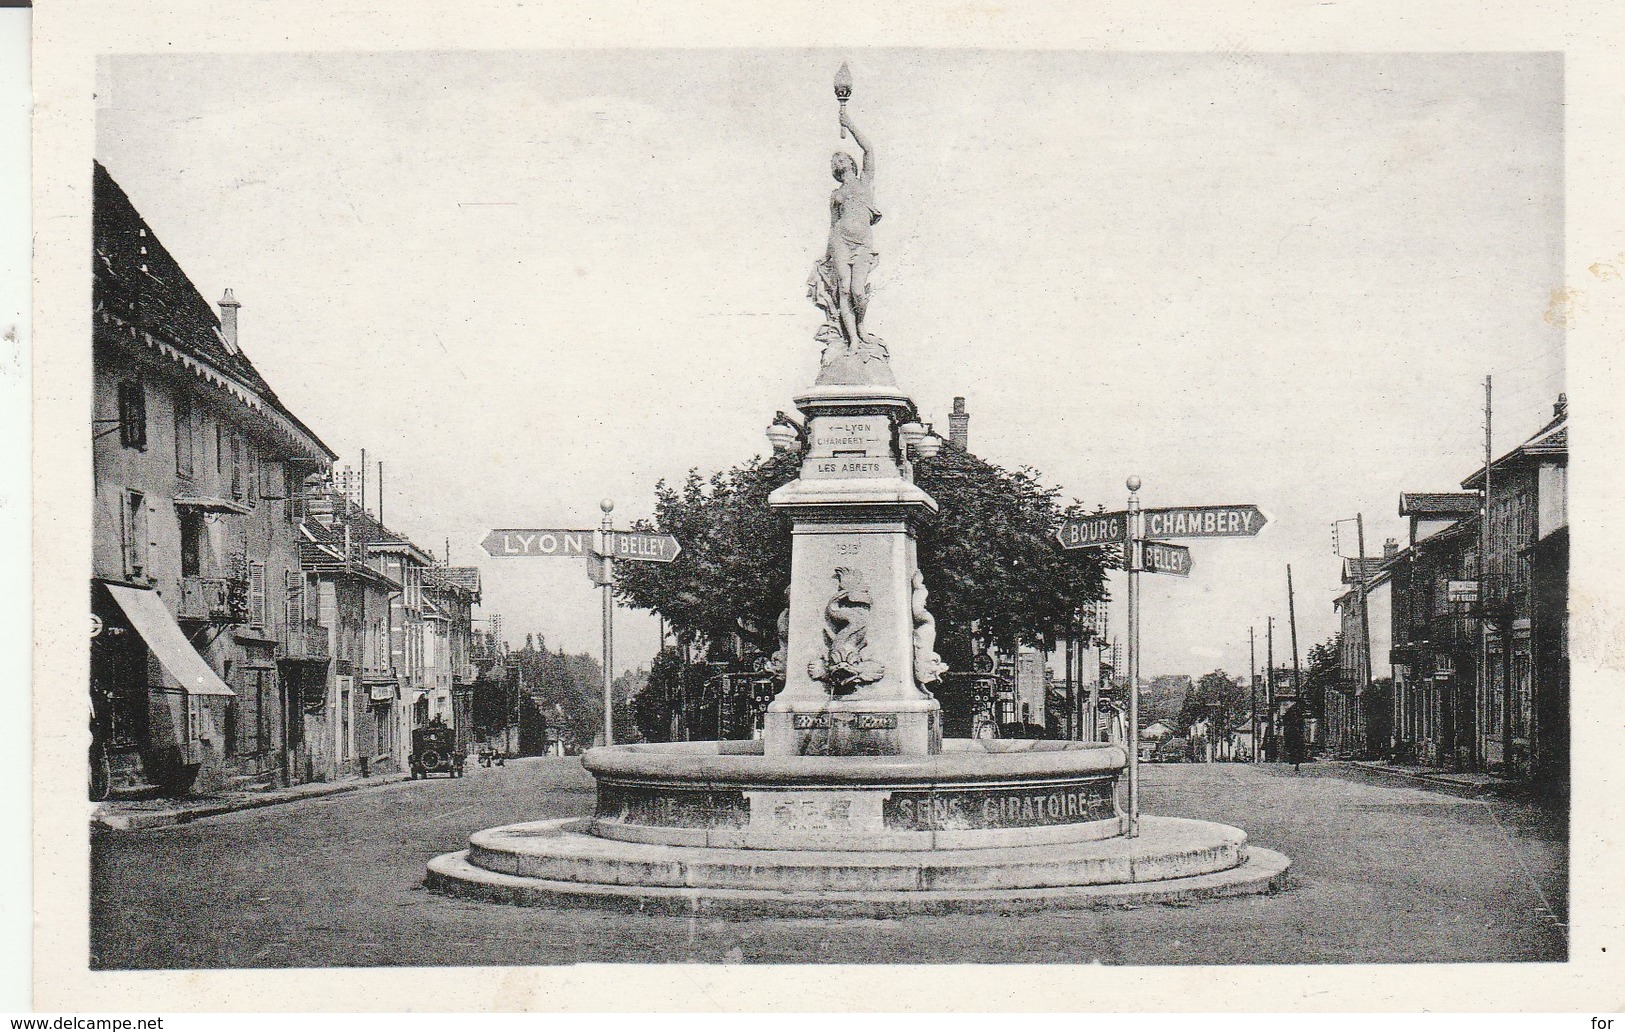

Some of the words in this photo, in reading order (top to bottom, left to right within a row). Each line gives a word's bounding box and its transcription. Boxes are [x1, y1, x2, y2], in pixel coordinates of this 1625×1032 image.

[845, 424, 871, 432] LYON
[818, 464, 836, 472] LES
[842, 463, 880, 472] ABRETS
[1070, 518, 1118, 543] BOURG
[504, 534, 583, 553] LYON
[620, 536, 666, 556] BELLEY
[1145, 547, 1184, 570] BELLEY
[982, 793, 1087, 822] GIRATOIRE
